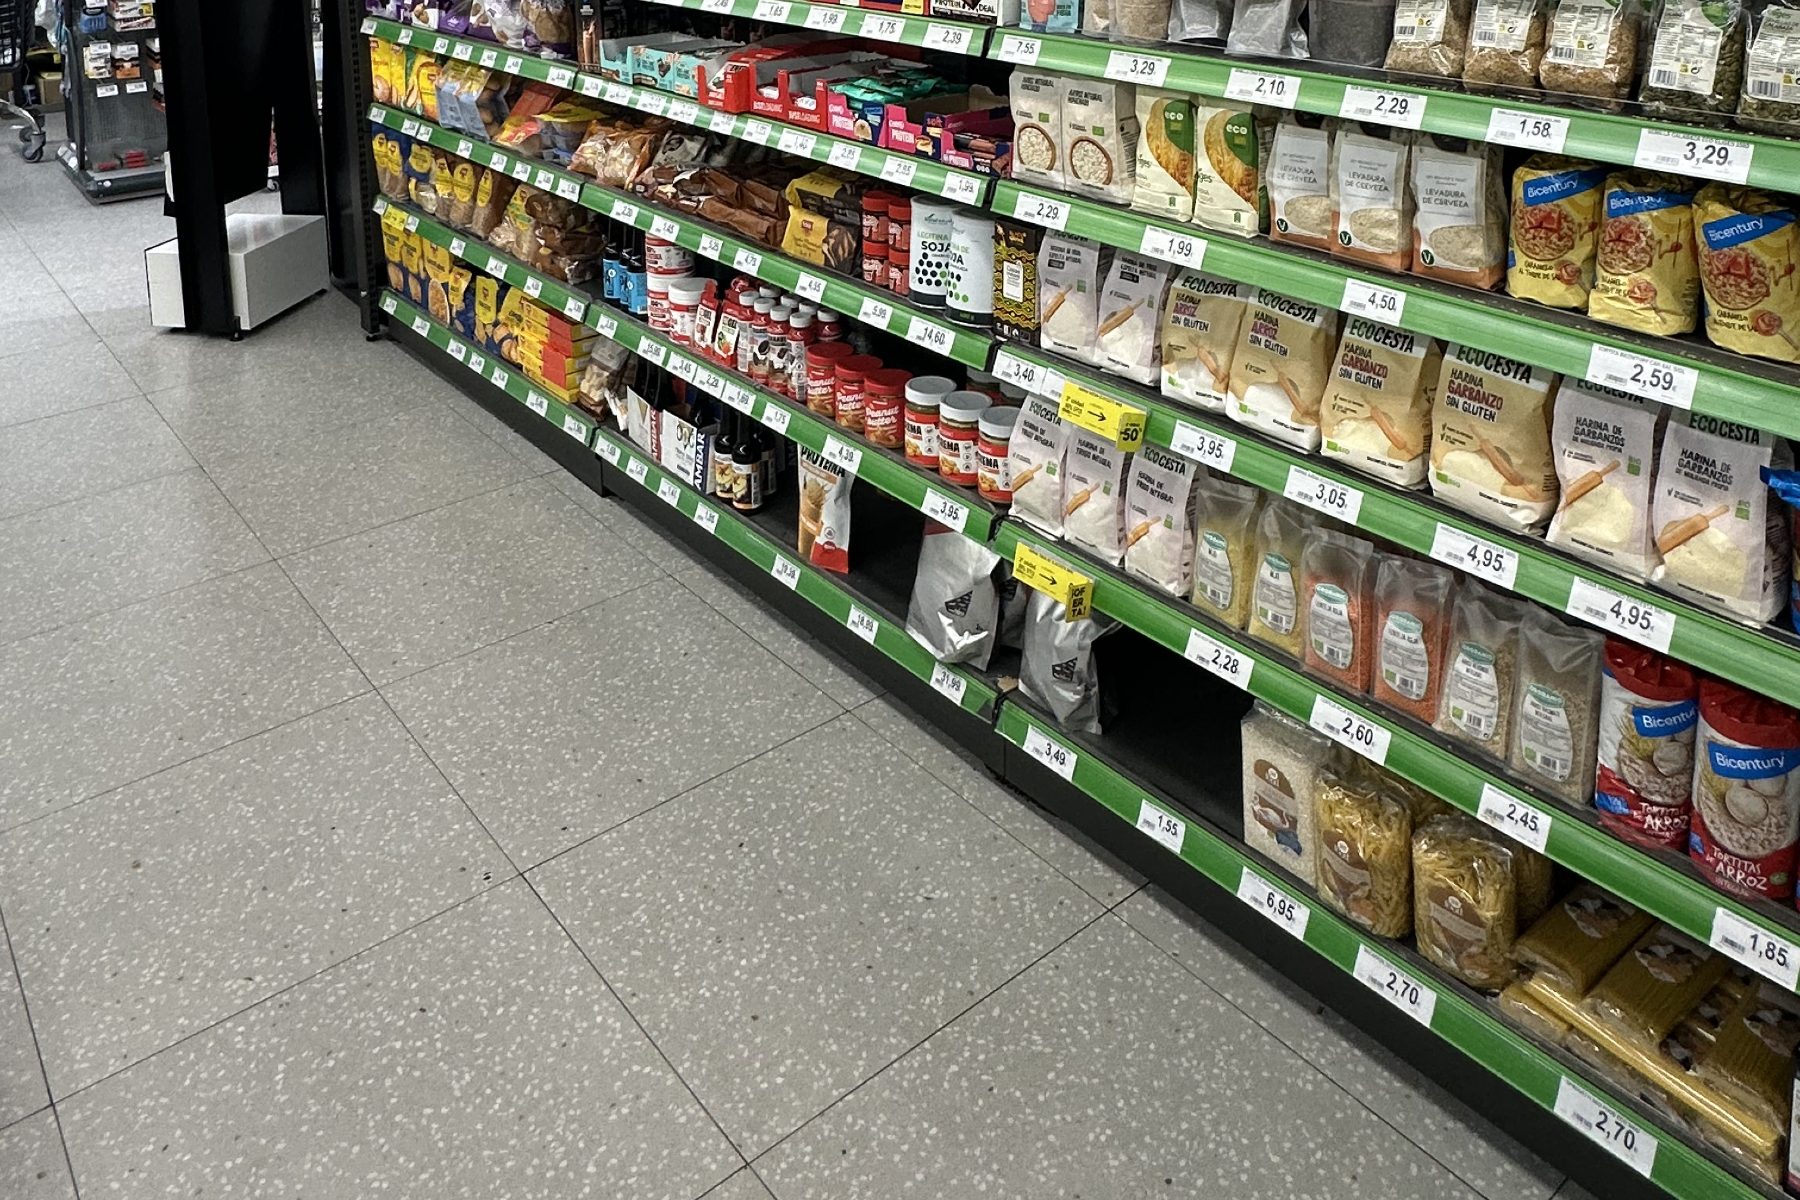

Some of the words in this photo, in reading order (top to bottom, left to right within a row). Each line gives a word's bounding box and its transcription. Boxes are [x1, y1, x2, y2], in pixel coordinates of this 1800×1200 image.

[979, 5, 995, 14] DEAL
[1017, 42, 1034, 53] 7,55
[1130, 60, 1155, 75] 3,29
[1255, 78, 1285, 95] 2,10
[1375, 95, 1409, 115] 2,29
[1226, 124, 1247, 135] eco
[1519, 118, 1551, 137] 1,58
[1683, 141, 1729, 166] 3,29
[1527, 179, 1578, 198] Bicentury
[1037, 203, 1058, 219] 2,29
[1708, 218, 1764, 241] Bicentury
[921, 241, 951, 252] SOJA
[1168, 239, 1192, 257] 1,99
[1182, 275, 1236, 297] ECOCESTA
[1258, 289, 1317, 323] ECOCESTA
[1368, 292, 1395, 311] 4,50
[923, 327, 945, 345] 14,60
[1251, 322, 1278, 339] ARROZ
[1350, 319, 1415, 353] ECOCESTA
[1344, 343, 1372, 359] HARINA
[1014, 365, 1034, 382] 3,40
[1342, 354, 1388, 379] GARBANZO
[1456, 346, 1532, 383] ECOCESTA
[1339, 367, 1352, 379] SIN
[1354, 371, 1382, 390] GLUTEN
[1451, 369, 1484, 387] HARINA
[1630, 363, 1674, 390] 2,59
[1448, 381, 1503, 410] GARBANZO
[865, 405, 899, 418] Peanut
[1446, 396, 1460, 409] SIN
[1462, 401, 1496, 422] GLUTEN
[1574, 427, 1625, 446] GARBANZOS
[1576, 417, 1609, 431] HARINA
[1613, 425, 1622, 435] DE
[1689, 412, 1760, 445] ECOCESTA
[1197, 437, 1223, 458] 3,95
[694, 433, 706, 488] AMBAR
[1144, 448, 1186, 475] ECOCESTA
[1678, 458, 1733, 485] GARBANZOS
[1681, 449, 1716, 468] HARINA
[1720, 463, 1731, 472] DE
[1315, 484, 1346, 508] 3,05
[1467, 548, 1503, 572] 4,95
[1073, 598, 1083, 607] ER
[1610, 600, 1651, 629] 4,95
[1211, 649, 1239, 674] 2,28
[1643, 709, 1695, 728] Bicentu
[1342, 718, 1374, 746] 2,60
[1046, 742, 1067, 766] 3,49
[1715, 752, 1784, 770] Bicentury
[1157, 814, 1179, 837] 1,55
[1506, 804, 1538, 832] 2,45
[1644, 814, 1690, 830] ARROZ
[1711, 846, 1761, 874] TORTITAS
[1715, 864, 1768, 891] ARROZ
[1266, 891, 1295, 921] 6,95
[1749, 933, 1787, 968] 1,85
[1385, 972, 1419, 1006] 2,70
[1595, 1111, 1636, 1151] 2,70
